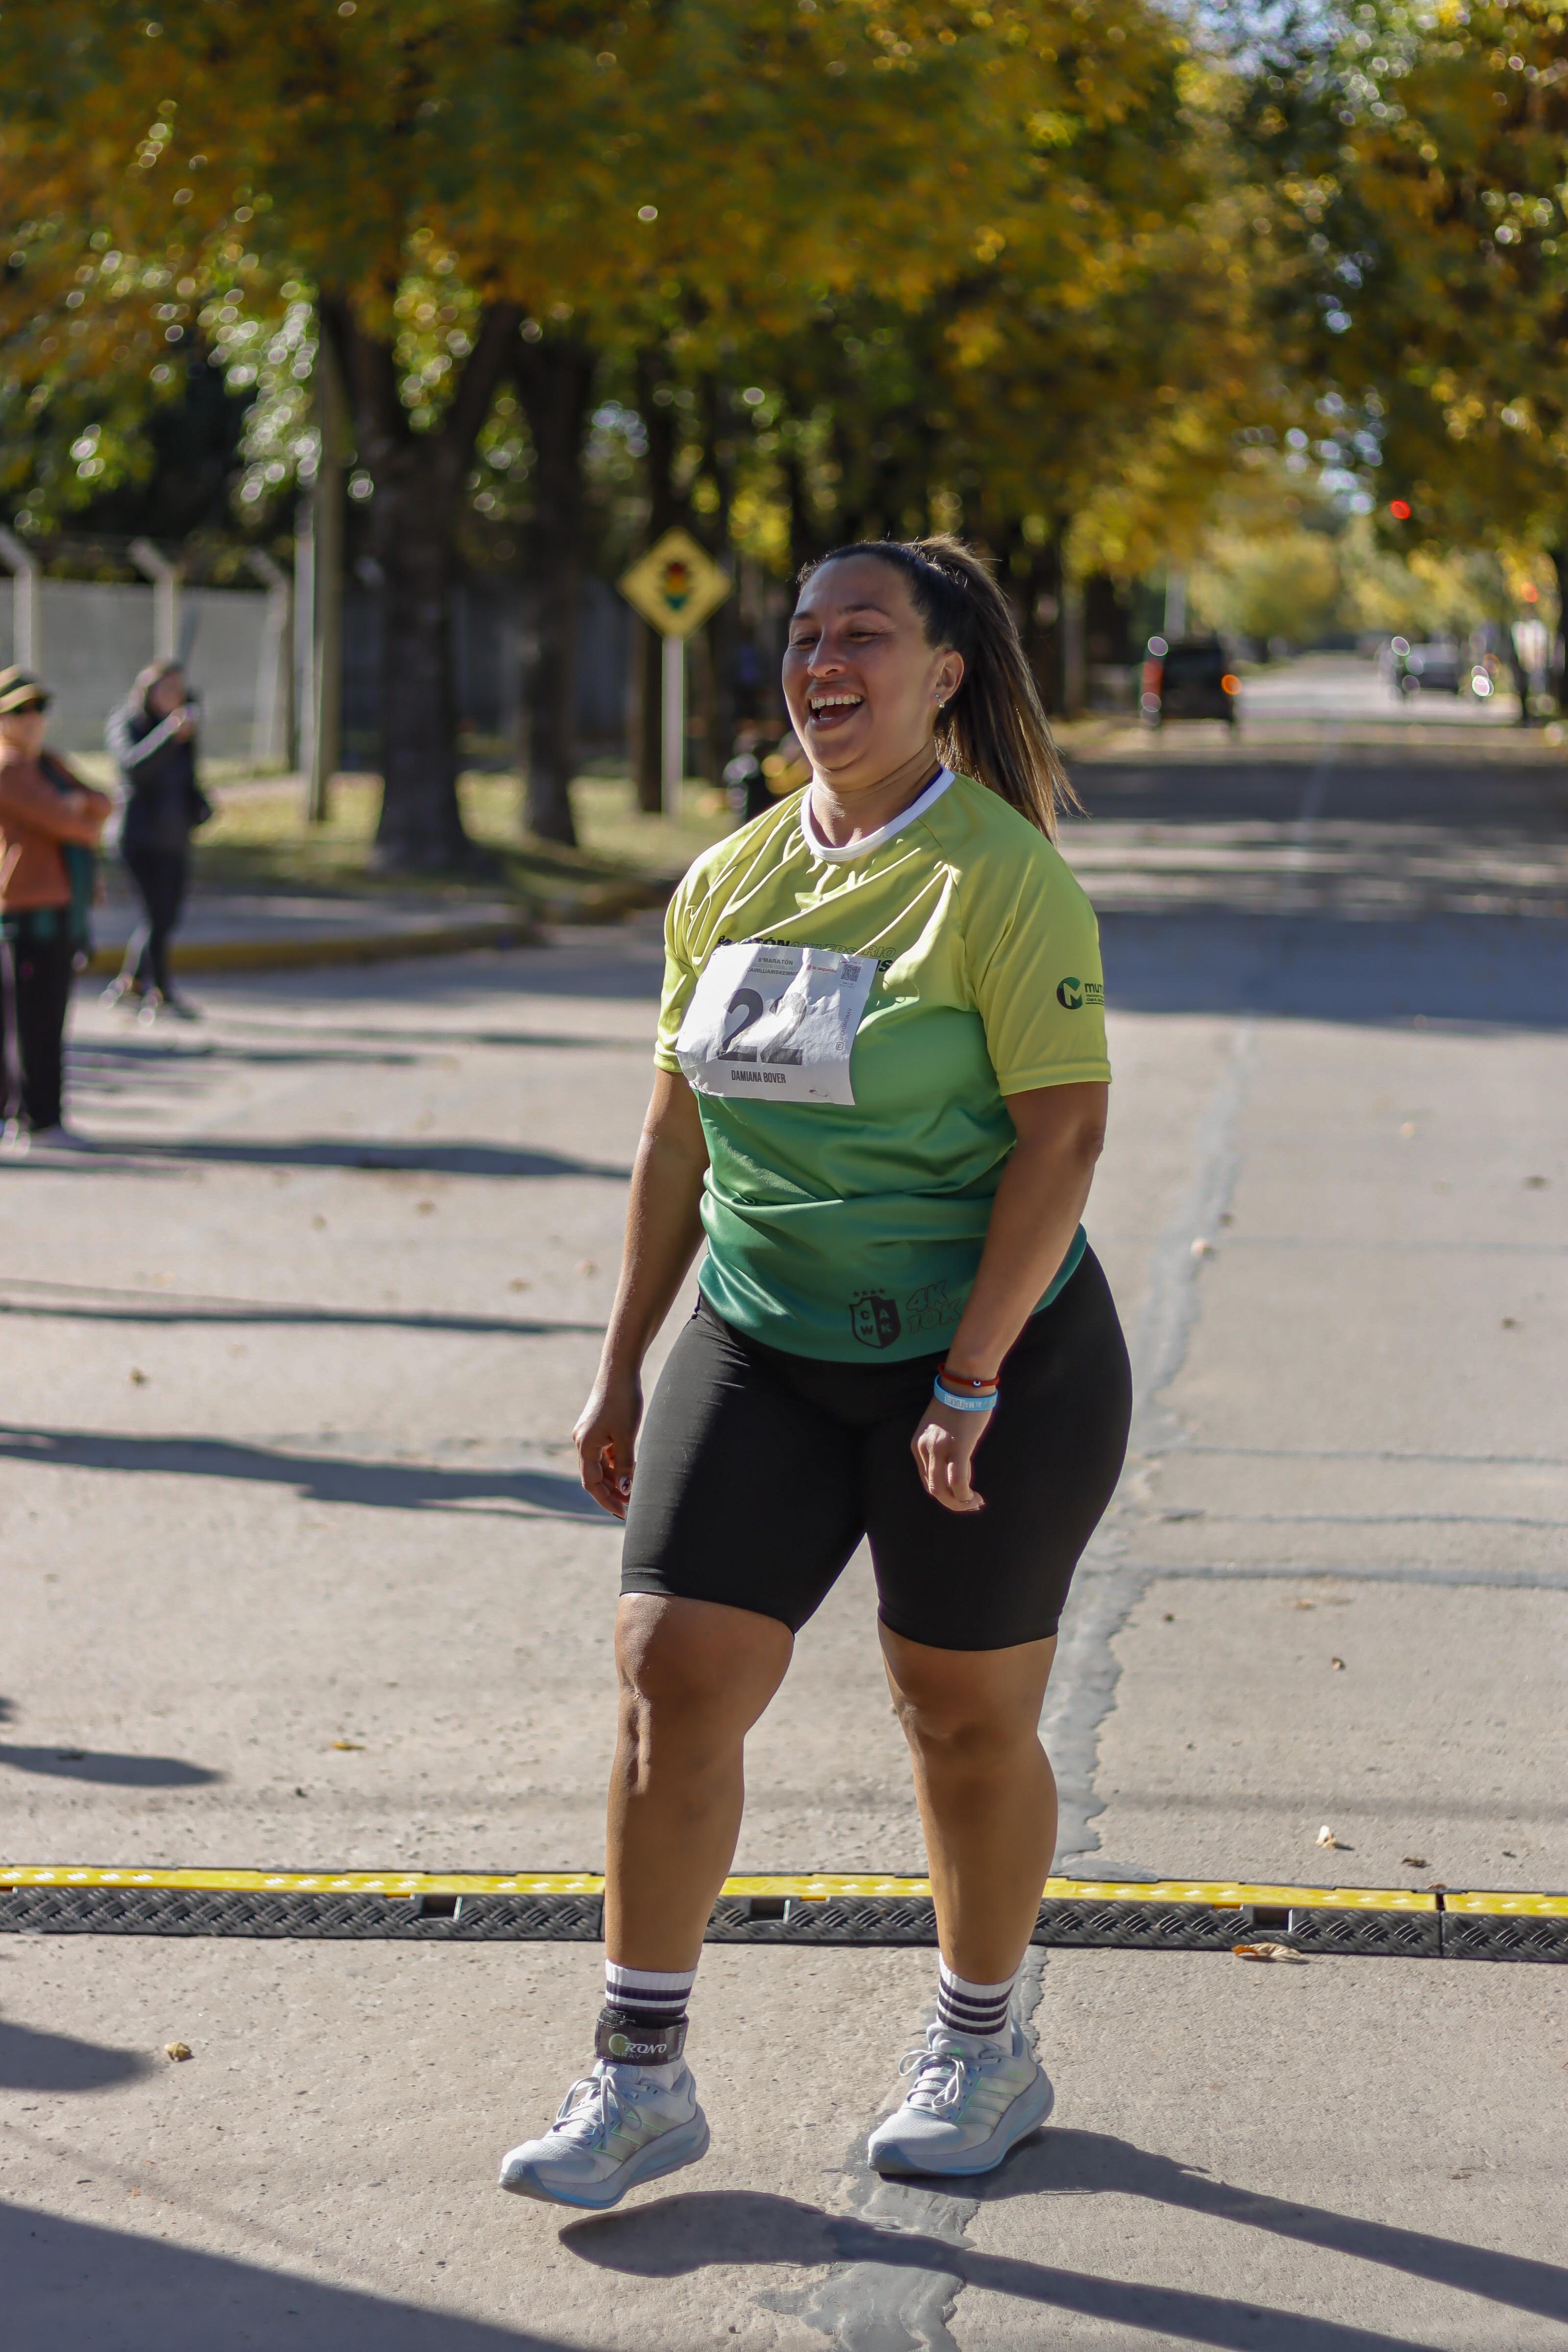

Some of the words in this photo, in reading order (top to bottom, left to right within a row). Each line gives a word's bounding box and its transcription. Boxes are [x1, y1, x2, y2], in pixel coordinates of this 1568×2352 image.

[717, 988, 807, 1066] 22
[731, 1070, 762, 1082] DAMIANA
[763, 1072, 786, 1083] BOVER
